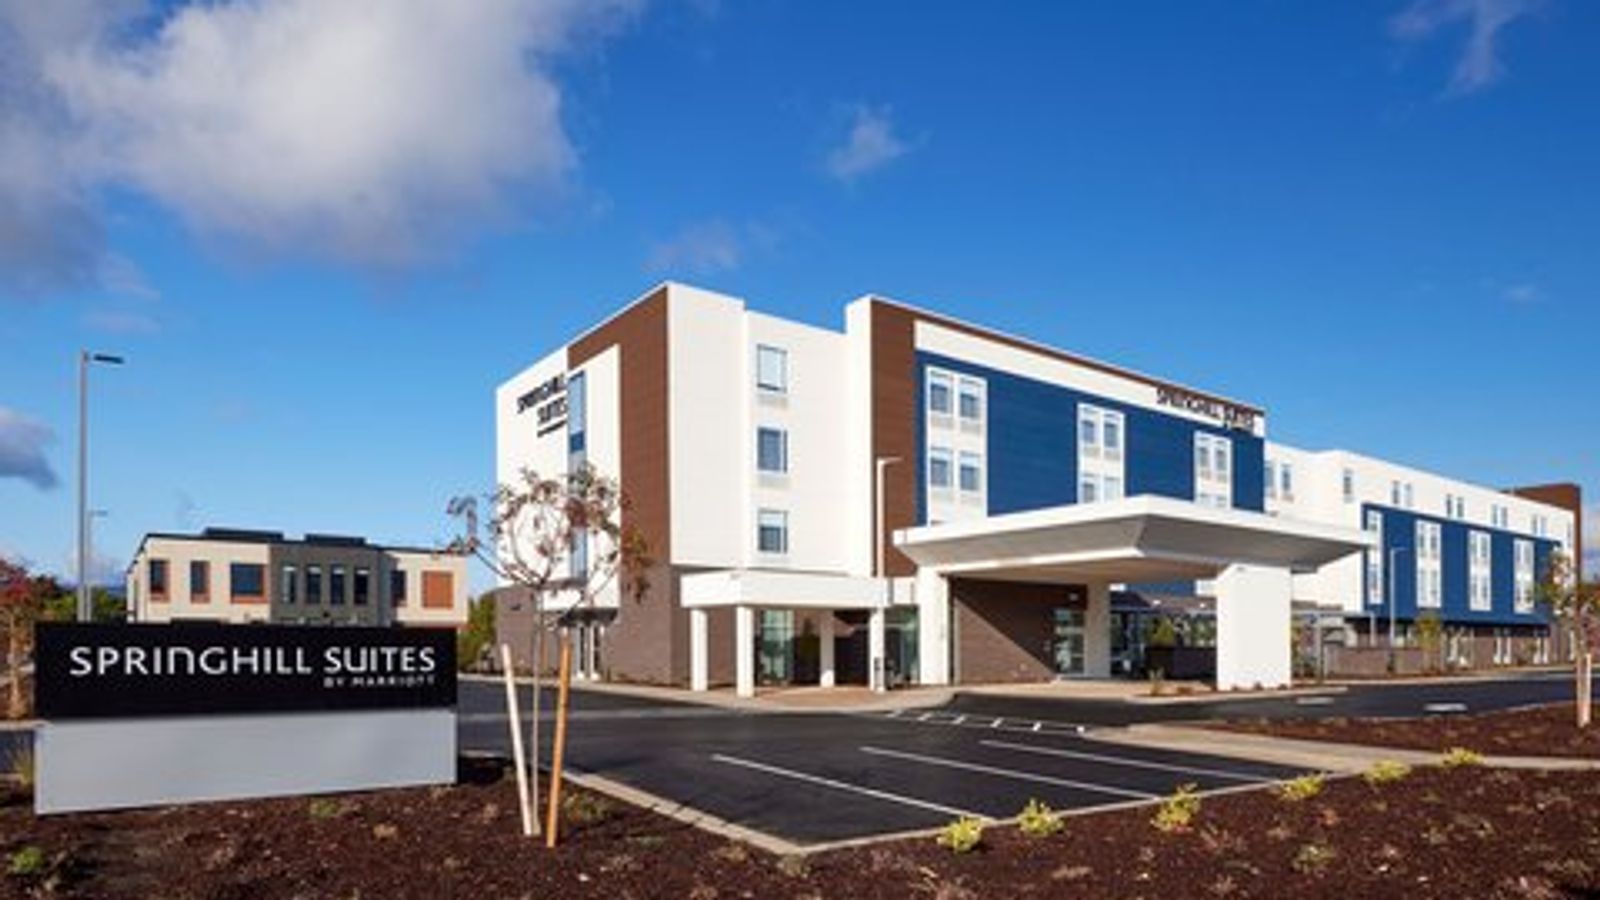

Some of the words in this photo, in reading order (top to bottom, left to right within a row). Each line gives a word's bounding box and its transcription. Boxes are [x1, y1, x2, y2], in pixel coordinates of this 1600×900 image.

[69, 646, 312, 675] SPRINGHILL
[323, 646, 436, 673] SUITES
[323, 677, 346, 688] BY
[351, 675, 436, 687] MARRIOTT
